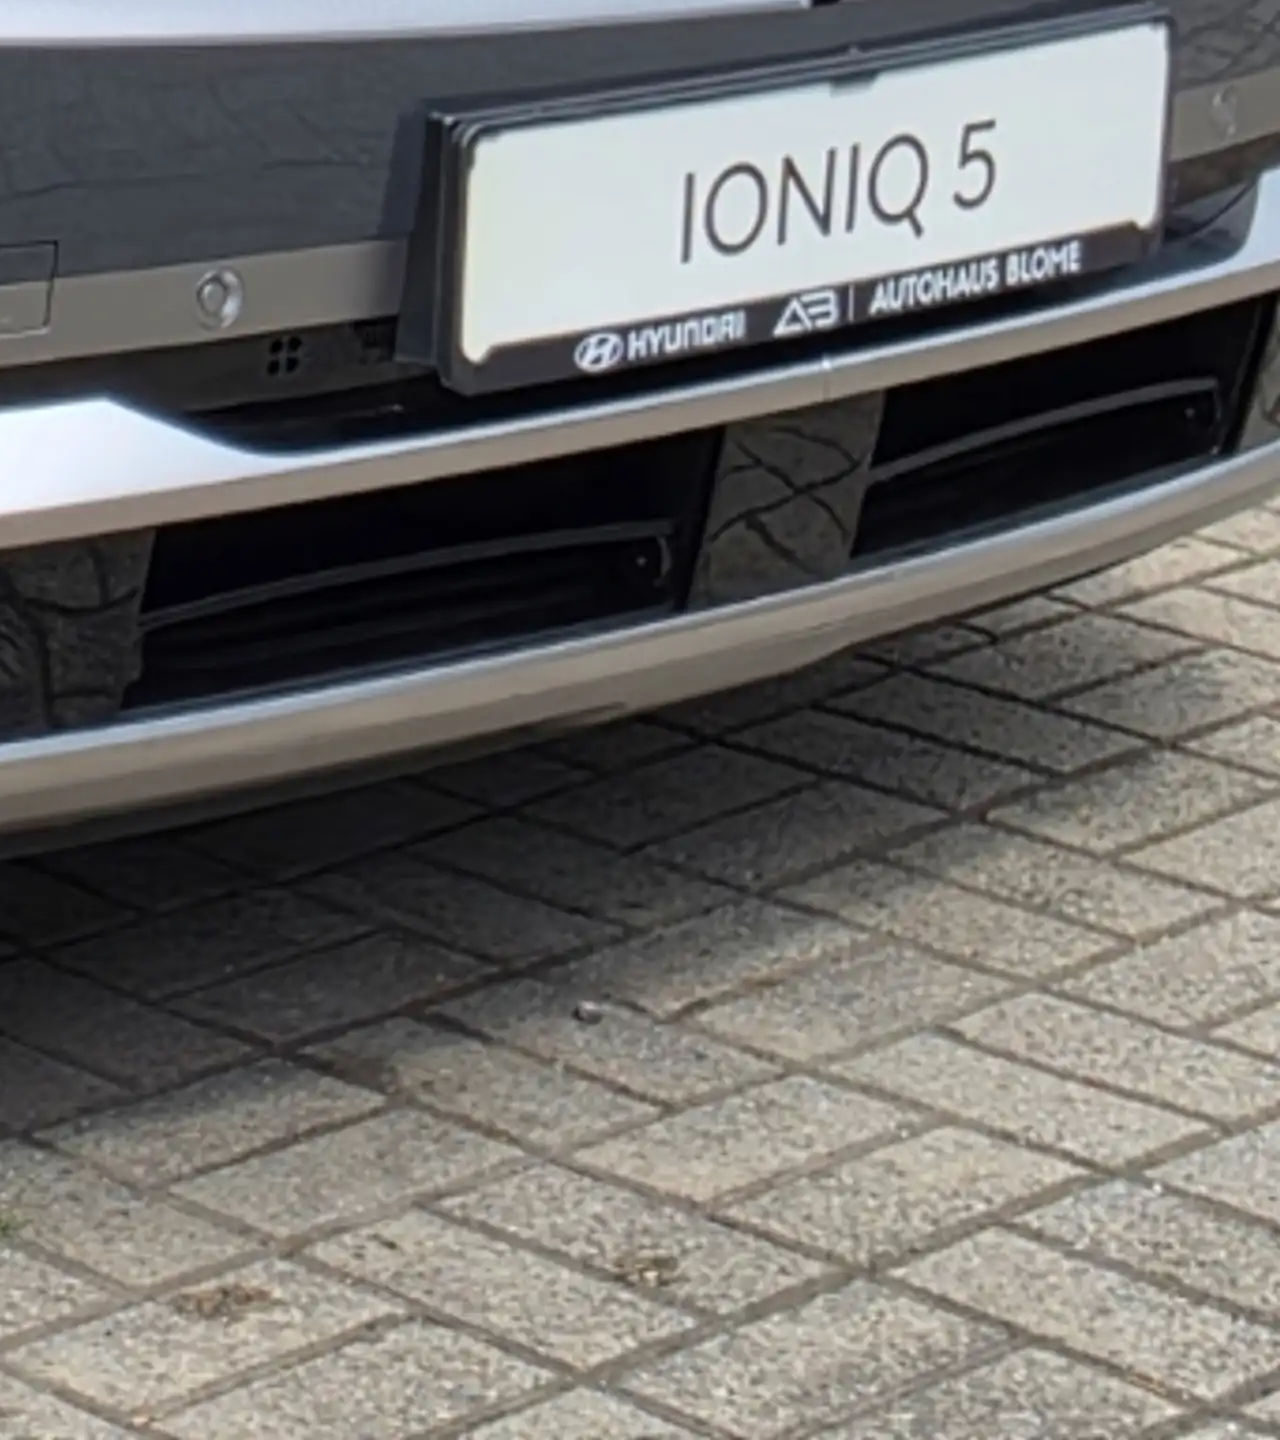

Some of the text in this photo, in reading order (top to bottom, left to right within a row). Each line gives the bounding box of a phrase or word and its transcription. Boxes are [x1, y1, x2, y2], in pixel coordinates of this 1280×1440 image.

[681, 119, 996, 264] IONIQ 5
[869, 240, 1081, 315] AUTOHAUS BLOME
[627, 310, 746, 360] HYUNDAI
